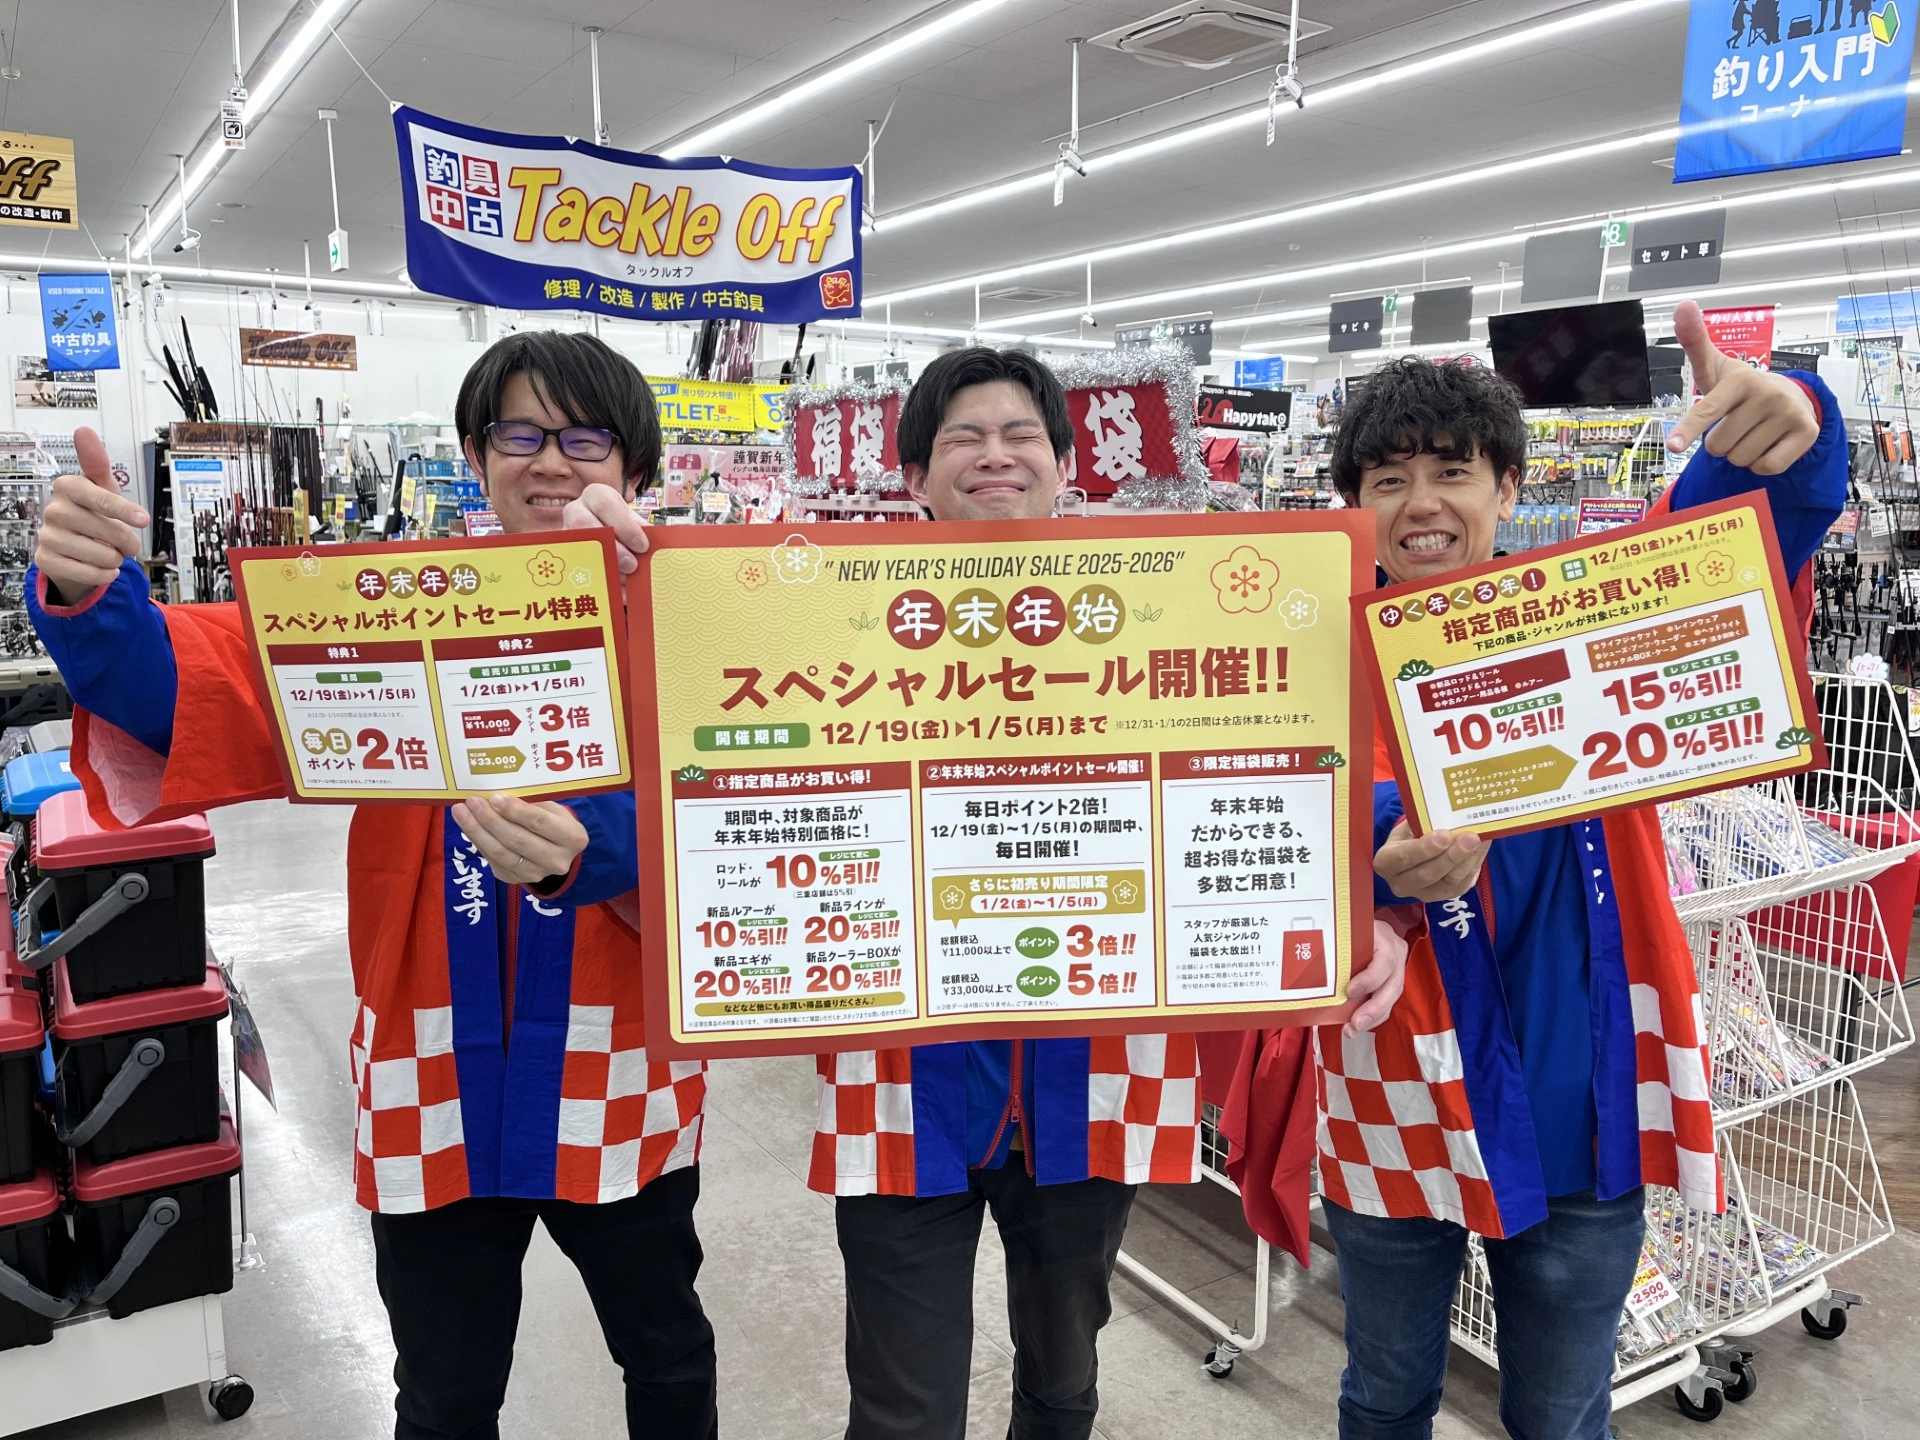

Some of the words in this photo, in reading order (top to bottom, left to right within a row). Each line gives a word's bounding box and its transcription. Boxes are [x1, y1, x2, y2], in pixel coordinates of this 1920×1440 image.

[1712, 33, 1877, 100] 釣り入門
[1740, 94, 1836, 122] コーナー
[0, 156, 61, 201] ff
[425, 147, 498, 195] 釣具
[430, 194, 501, 236] 中古
[509, 167, 720, 256] Tackle
[736, 194, 845, 263] Off
[1642, 242, 1710, 263] セット竿
[626, 263, 694, 279] タックルオフ
[84, 287, 105, 295] TACKLE
[544, 278, 581, 299] 修理
[599, 284, 634, 308] 改造
[651, 291, 684, 310] 製作
[702, 290, 765, 312] 中古釣具
[1178, 323, 1206, 335] サビキ
[1340, 321, 1370, 333] サビキ
[51, 332, 111, 347] 中古釣具
[248, 336, 311, 360] Tackle
[315, 339, 350, 362] Off
[681, 389, 741, 401] 売り切り大特価!!
[713, 414, 740, 422] コーナー
[811, 403, 885, 477] 福袋
[1067, 389, 1148, 482] 袋
[733, 450, 785, 465] 謹賀新年
[1589, 537, 1665, 566] 12/19(金)
[1685, 517, 1744, 541] 1/5(月)
[838, 560, 880, 581] NEW
[886, 559, 945, 580] YEAR'S
[950, 556, 1026, 579] HOLIDAY
[1029, 554, 1074, 577] SALE
[358, 567, 478, 597] 年末年始
[263, 594, 599, 633] スペシャルポイントセール特典
[1442, 561, 1690, 645] 指定商品がお買い得!
[893, 592, 1120, 641] 年末年始
[1473, 595, 1669, 652] 下記の商品・ジャンルが対象になります!
[328, 646, 359, 659] 特典1
[498, 637, 533, 651] 特典2
[460, 682, 512, 698] 1/2(金)
[530, 676, 585, 692] 1/5(月)
[719, 645, 1289, 711] スペシャルセール開催!!
[290, 688, 351, 701] 12/19(金)
[367, 688, 416, 701] 1/5(月)
[539, 703, 590, 732] 3倍
[715, 728, 789, 746] 開催期間
[821, 719, 949, 746] 12/19(金)
[967, 714, 1108, 740] 1/5(月)まで
[304, 731, 348, 751] 毎日
[356, 727, 429, 770] 2倍
[307, 757, 355, 771] ポイント
[545, 740, 604, 772] 5倍
[1189, 753, 1300, 771] ③限定福袋販売!
[724, 805, 863, 826] 期間中、対象商品が
[964, 797, 1108, 818] 毎日ポイント2倍!
[1210, 795, 1284, 816] 年末年始
[714, 823, 869, 846] 年末年始特別価格に!
[1191, 821, 1303, 843] だからできる、
[996, 839, 1079, 859] 毎日開催!
[1184, 845, 1312, 869] 超お得な福袋を
[717, 876, 761, 889] リールが
[969, 874, 1109, 893] さらに初売り期間限定
[1197, 872, 1296, 893] 多数ご用意!
[707, 904, 776, 917] 新品ルアーが
[819, 898, 886, 913] 新品ラインが
[1184, 916, 1269, 930] スタッフが厳選した
[940, 935, 979, 946] 総額税込
[1018, 936, 1056, 947] ポイント
[1066, 924, 1136, 958] 3倍!!
[1193, 931, 1260, 943] 人気ジャンルの
[714, 954, 772, 967] 新品エギが
[806, 946, 902, 963] 新品クーラーBOXが
[942, 945, 1012, 958] ¥11,000以上で
[1189, 944, 1262, 958] 福袋を大放出!!
[1295, 943, 1312, 961] 福
[941, 973, 980, 985] 総額税込
[943, 983, 1013, 996] ¥33,000以上で
[1019, 975, 1057, 986] ポイント
[1067, 963, 1137, 996] 5倍!!
